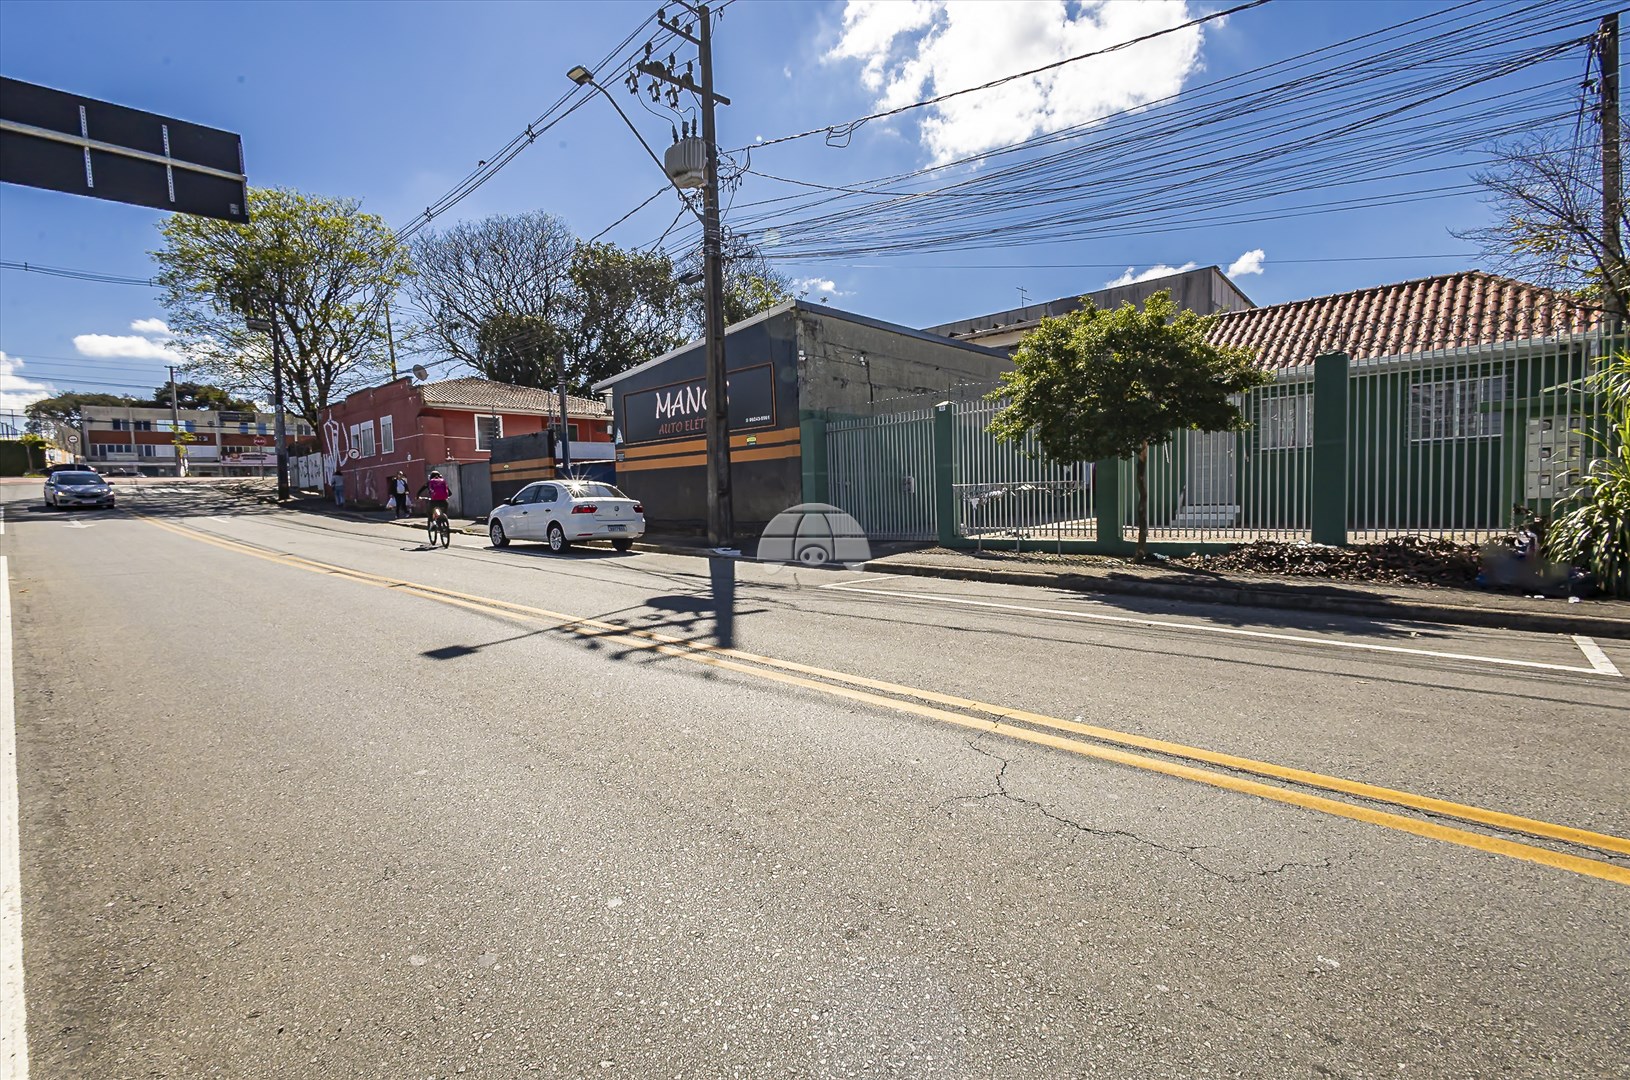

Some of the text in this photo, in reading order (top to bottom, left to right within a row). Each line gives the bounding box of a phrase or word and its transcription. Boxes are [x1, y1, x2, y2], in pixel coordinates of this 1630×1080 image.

[655, 380, 730, 419] MAN
[658, 416, 707, 435] AUTO ELÉT
